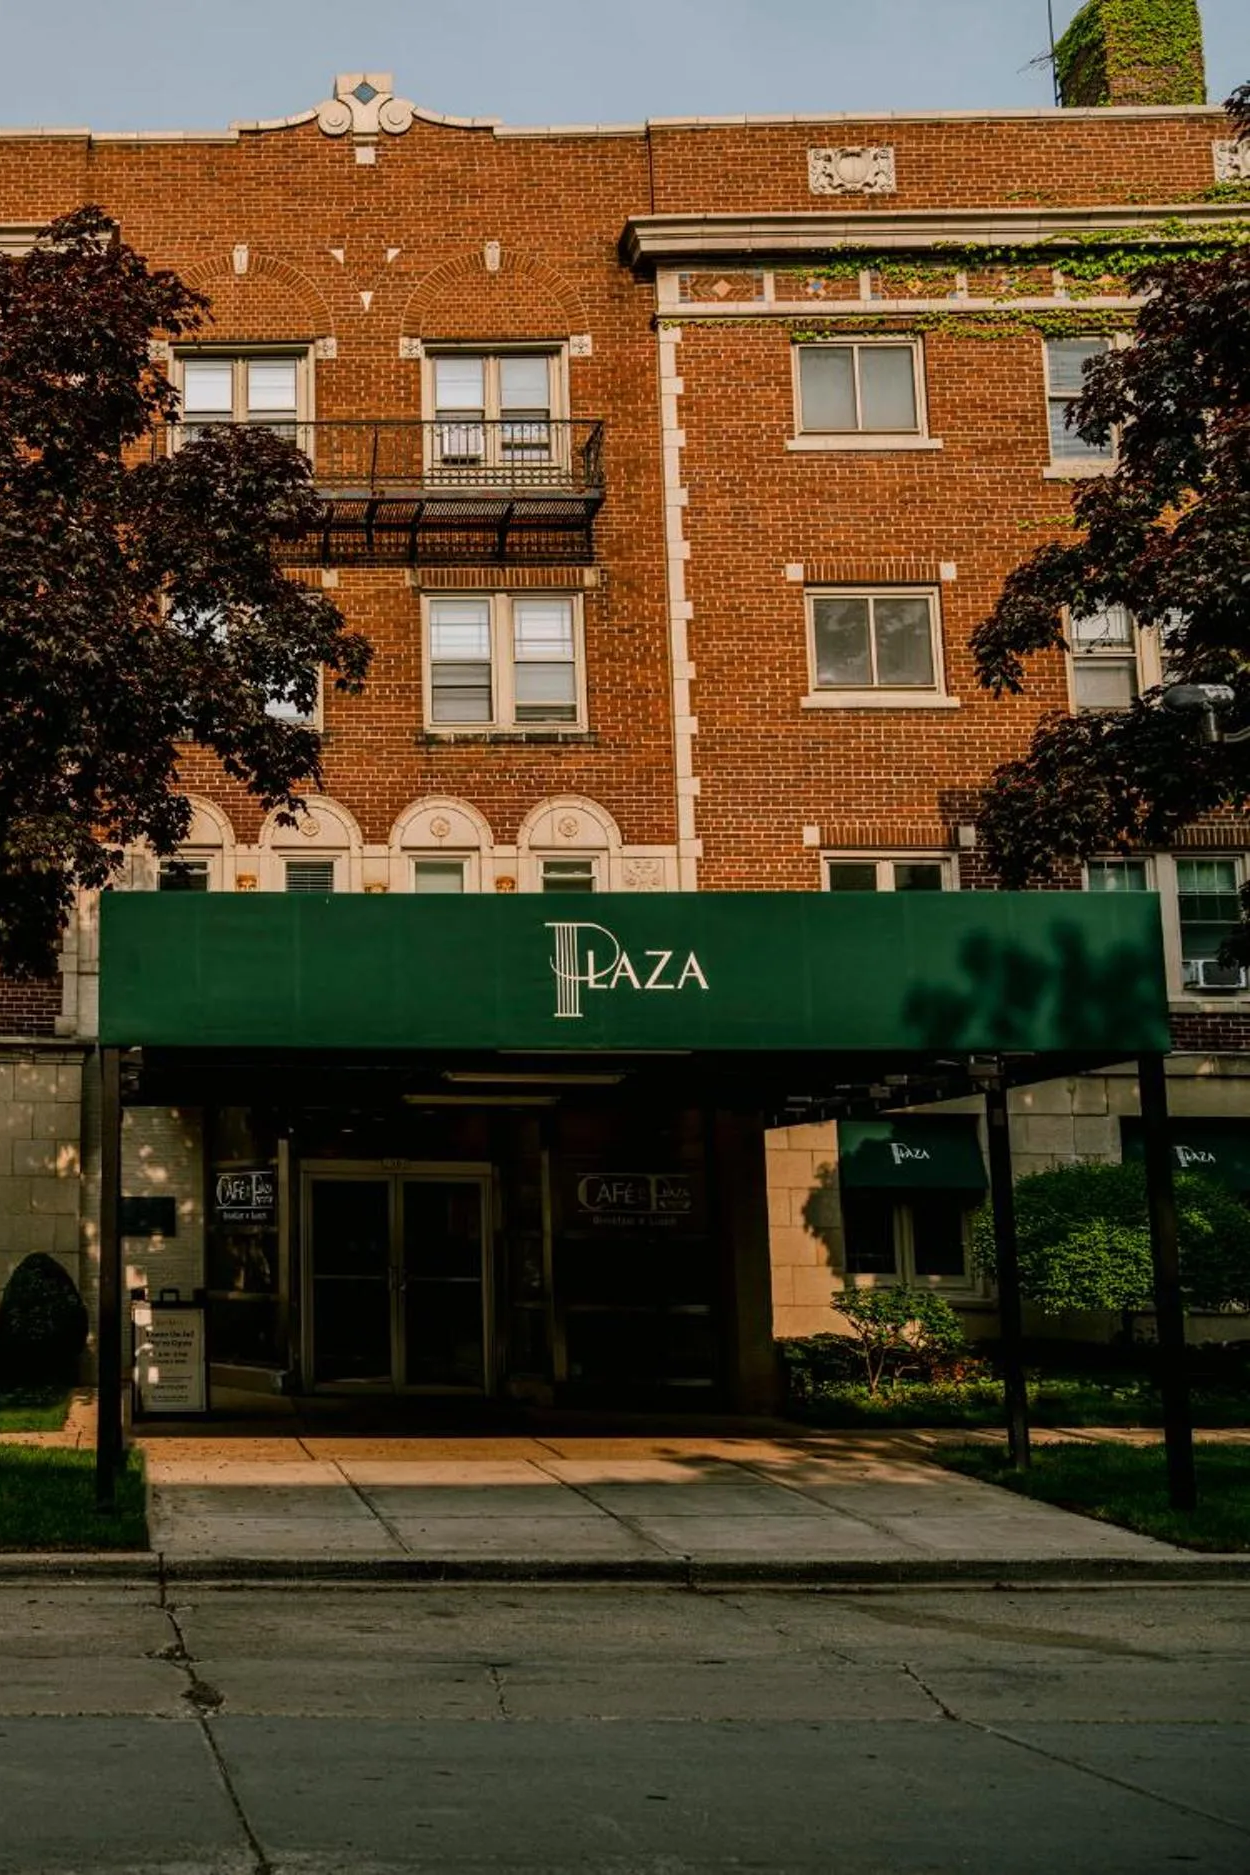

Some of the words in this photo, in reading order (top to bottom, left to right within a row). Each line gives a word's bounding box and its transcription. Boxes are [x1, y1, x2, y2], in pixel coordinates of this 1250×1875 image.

[545, 922, 709, 1017] PLAZA
[888, 1143, 931, 1165] PLAZA
[1173, 1145, 1216, 1168] PLAZA
